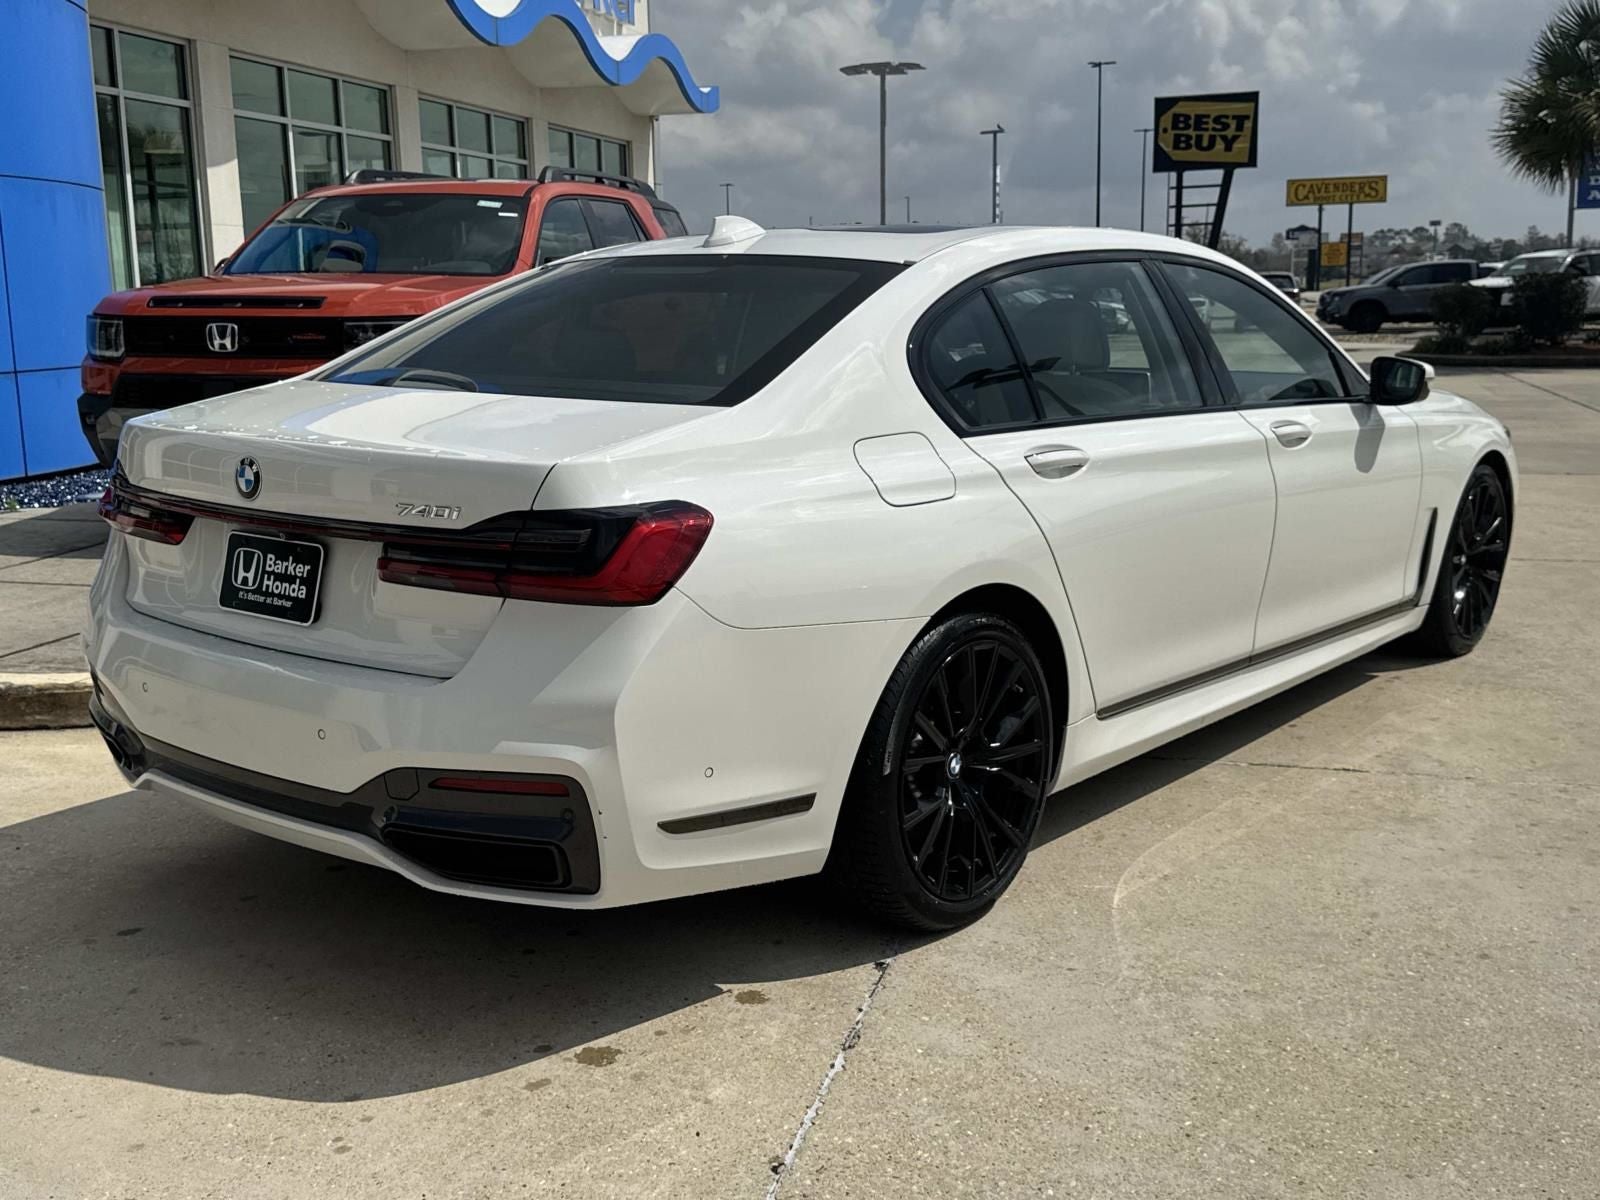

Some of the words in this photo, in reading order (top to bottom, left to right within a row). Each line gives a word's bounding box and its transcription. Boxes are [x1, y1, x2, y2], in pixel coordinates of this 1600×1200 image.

[1171, 113, 1250, 132] BEST
[1172, 133, 1242, 152] BUY
[1294, 180, 1379, 202] CAVENDER'S
[395, 502, 461, 520] 740i
[265, 553, 311, 577] Barker
[262, 574, 307, 599] Honda
[238, 591, 247, 600] It's
[247, 592, 265, 602] Better
[266, 596, 273, 604] at
[273, 597, 293, 607] Barker
